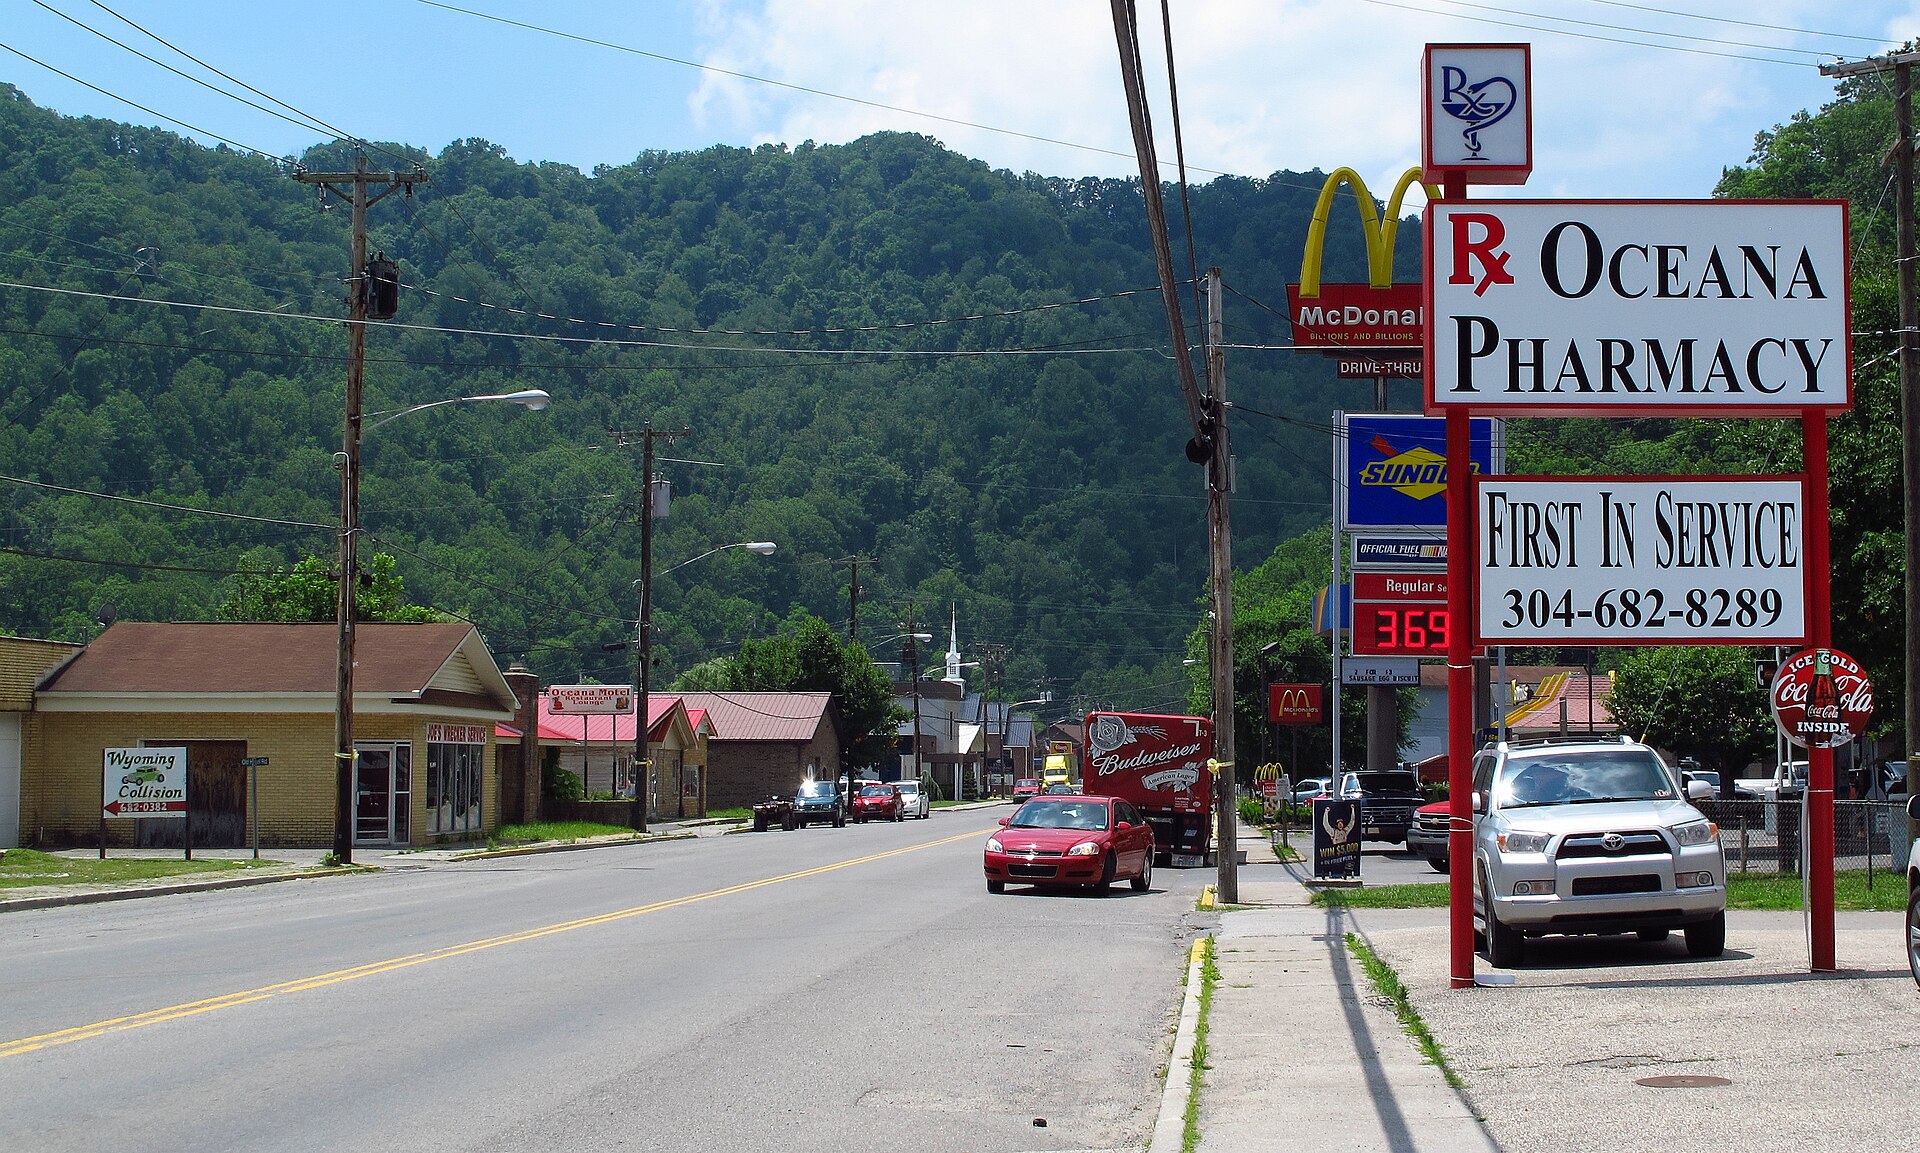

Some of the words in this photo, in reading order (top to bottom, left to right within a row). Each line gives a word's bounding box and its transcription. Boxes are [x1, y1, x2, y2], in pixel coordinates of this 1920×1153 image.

[1540, 220, 1828, 299] OCEANA
[1310, 332, 1350, 341] BILLIONS
[1353, 332, 1371, 341] AND
[1375, 332, 1414, 341] BILLIONS
[1449, 315, 1834, 394] PHARMACY
[1340, 362, 1422, 374] DRIVE-THRU
[1485, 490, 1583, 569] FIRST
[1598, 491, 1637, 569] IN
[1654, 489, 1798, 569] SERVICE
[1360, 543, 1397, 554] OFFICIAL
[1399, 544, 1420, 554] FUEL
[1386, 578, 1435, 595] Regular
[1501, 587, 1783, 629] 304-682-8289
[1788, 655, 1814, 673] ICE
[1821, 654, 1858, 674] COLD
[551, 688, 595, 696] Oceana
[599, 688, 630, 696] Motel
[1796, 721, 1850, 733] INSIDE
[107, 750, 176, 770] Wyoming
[1092, 743, 1201, 777] Budweiser
[1148, 773, 1176, 786] American
[1177, 772, 1195, 780] Lager
[118, 784, 183, 799] Collision
[1319, 846, 1335, 858] WIN
